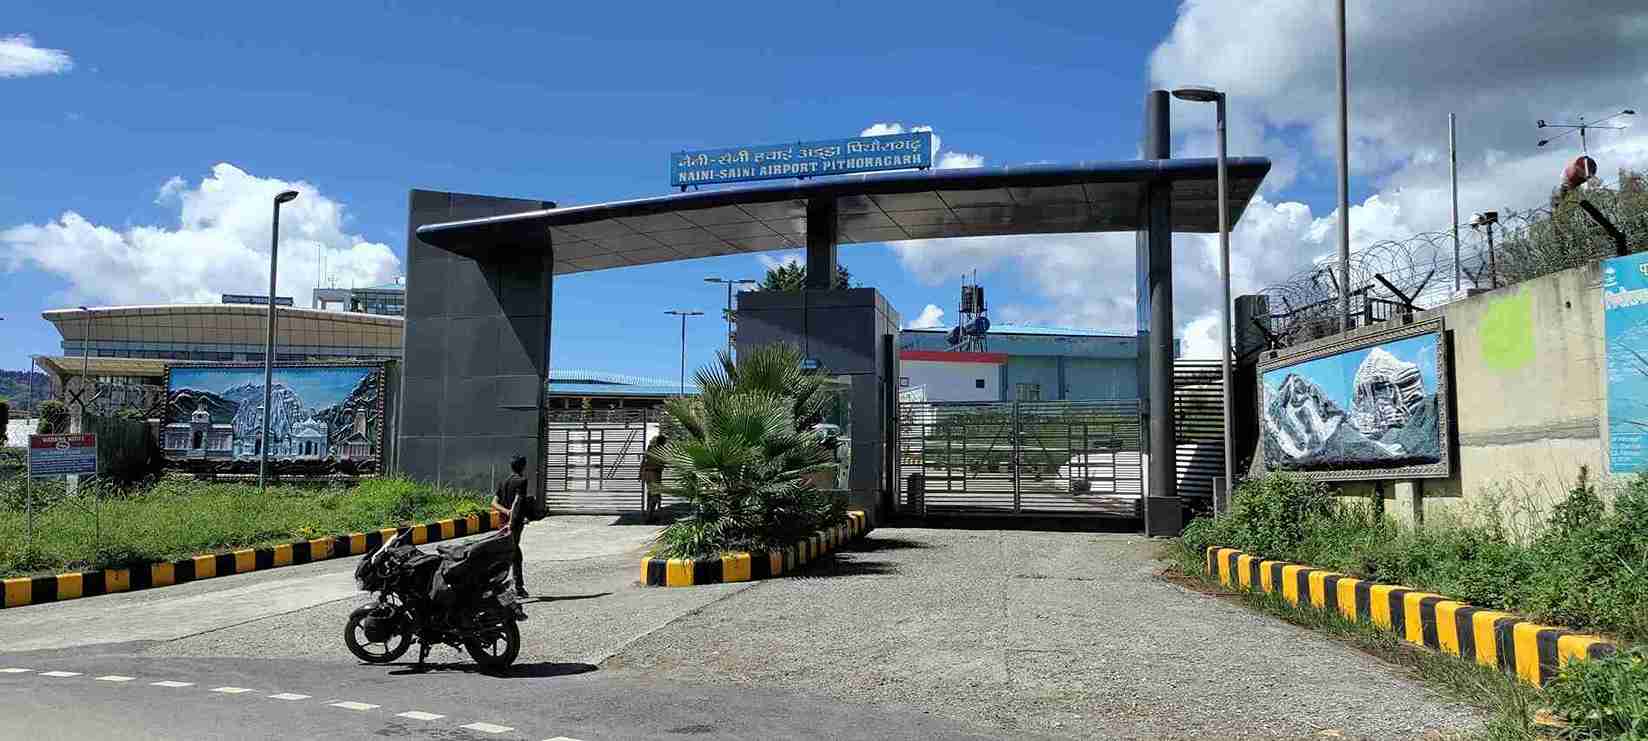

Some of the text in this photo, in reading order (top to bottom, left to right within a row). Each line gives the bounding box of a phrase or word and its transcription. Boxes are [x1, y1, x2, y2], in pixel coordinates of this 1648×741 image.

[678, 154, 921, 182] NAINI-SAINI AIRPORT PITHORAGARH
